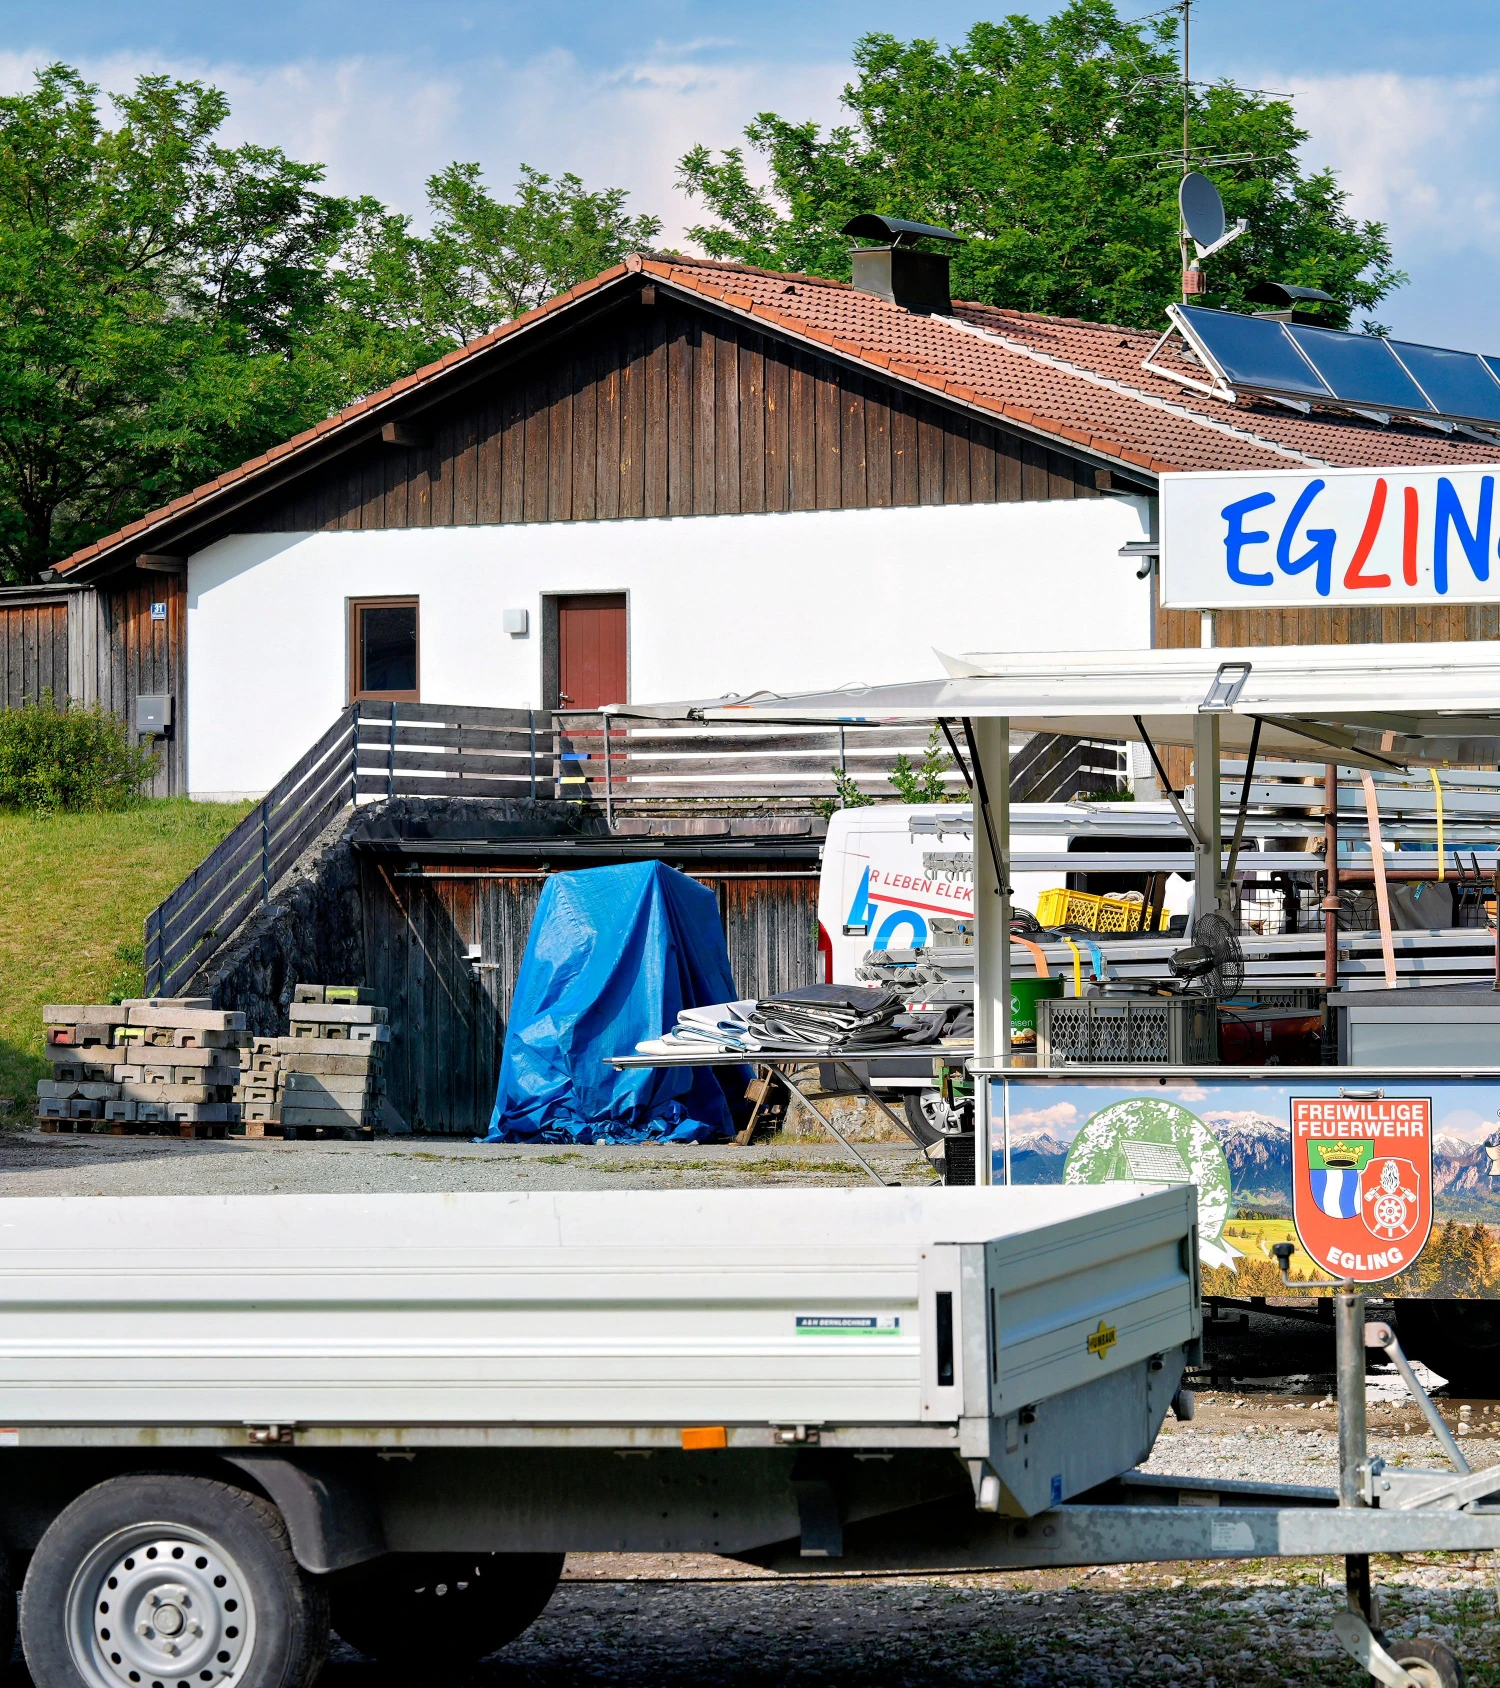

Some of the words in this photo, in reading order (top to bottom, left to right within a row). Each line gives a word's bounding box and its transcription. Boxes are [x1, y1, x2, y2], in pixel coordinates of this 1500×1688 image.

[154, 604, 163, 613] 31
[883, 871, 933, 894] LEBEN
[935, 882, 974, 902] ELEK
[1297, 1104, 1424, 1121] FREIWILLIGE
[1298, 1121, 1424, 1138] FEUERWEHR
[1326, 1245, 1404, 1271] EGLING
